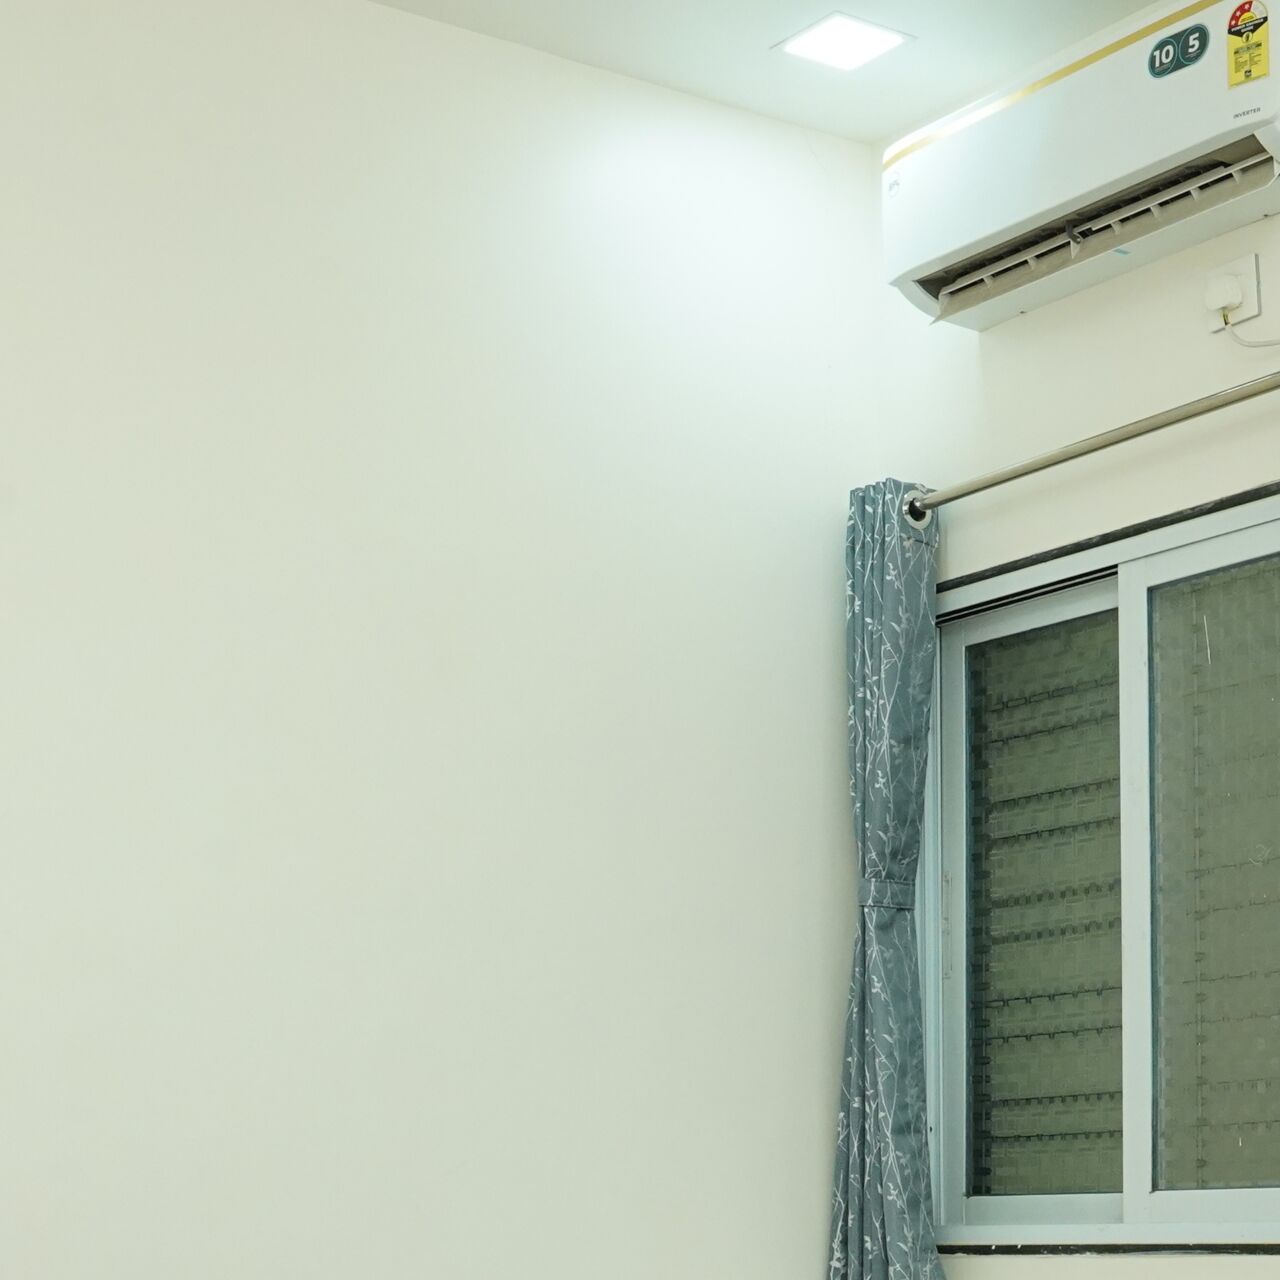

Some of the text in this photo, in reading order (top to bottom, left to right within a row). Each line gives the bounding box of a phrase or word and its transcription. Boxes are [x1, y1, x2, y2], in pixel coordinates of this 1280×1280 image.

[1188, 32, 1200, 53] 5
[1153, 45, 1175, 68] 10
[1233, 107, 1261, 120] INVERTER
